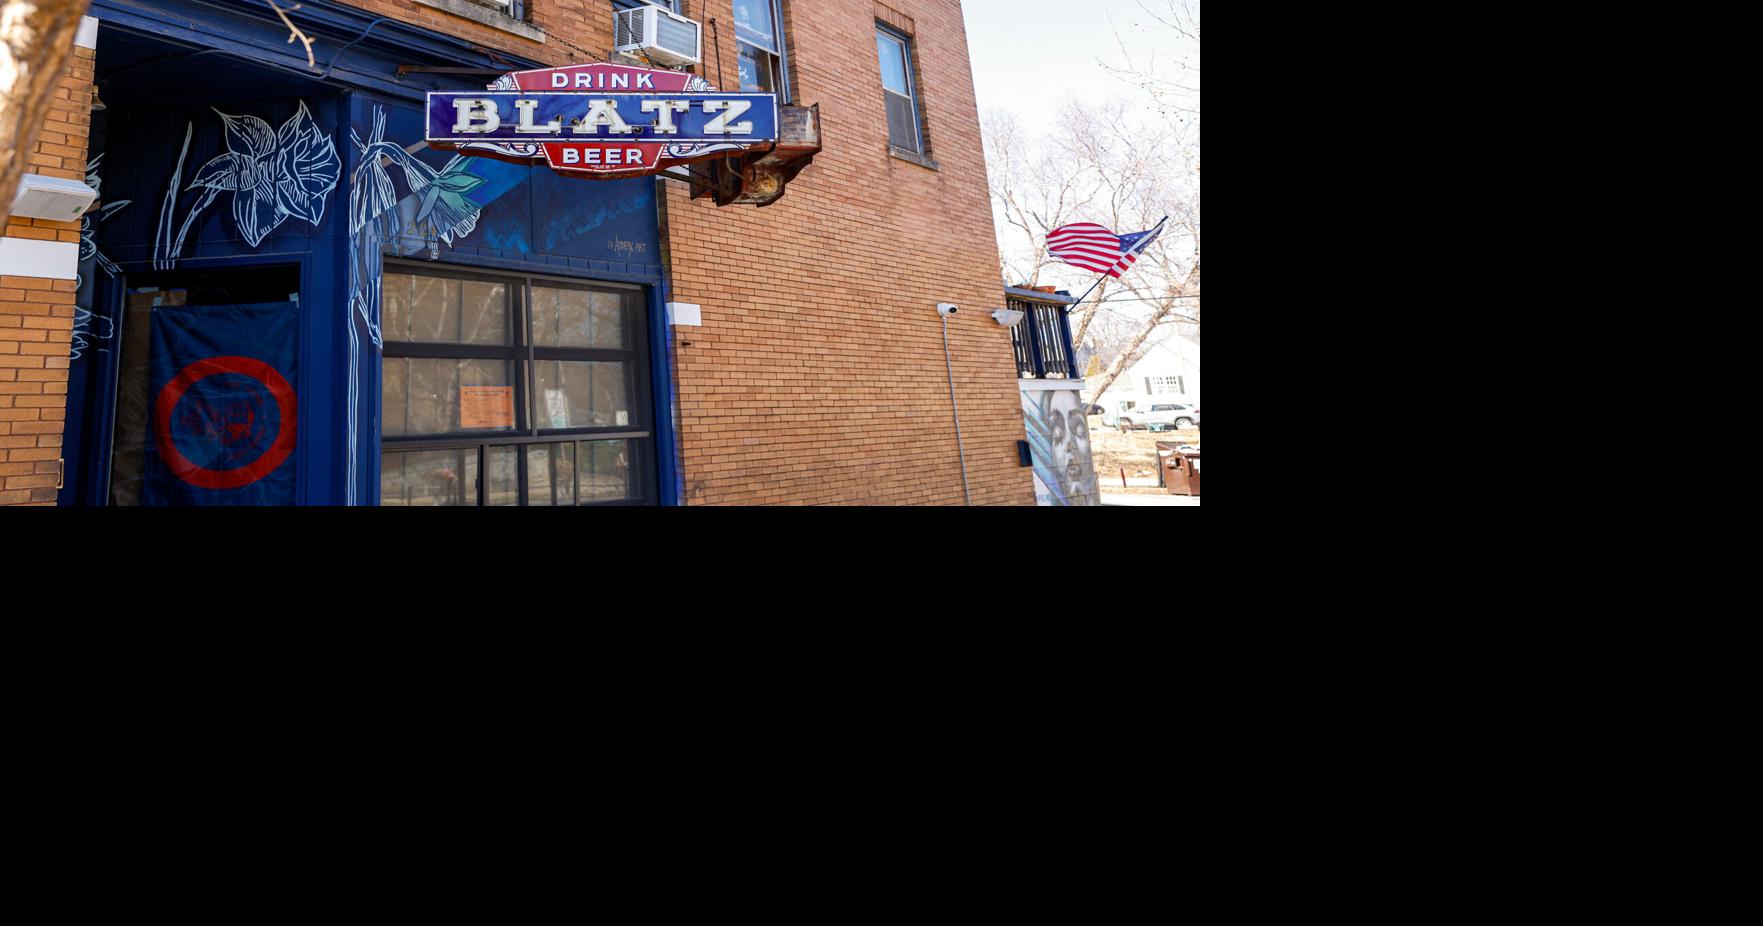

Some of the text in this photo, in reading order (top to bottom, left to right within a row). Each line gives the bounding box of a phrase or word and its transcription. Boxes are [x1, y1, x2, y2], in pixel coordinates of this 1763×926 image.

[551, 73, 655, 89] DRINK
[452, 98, 753, 135] BLATZ
[562, 147, 644, 165] BEER
